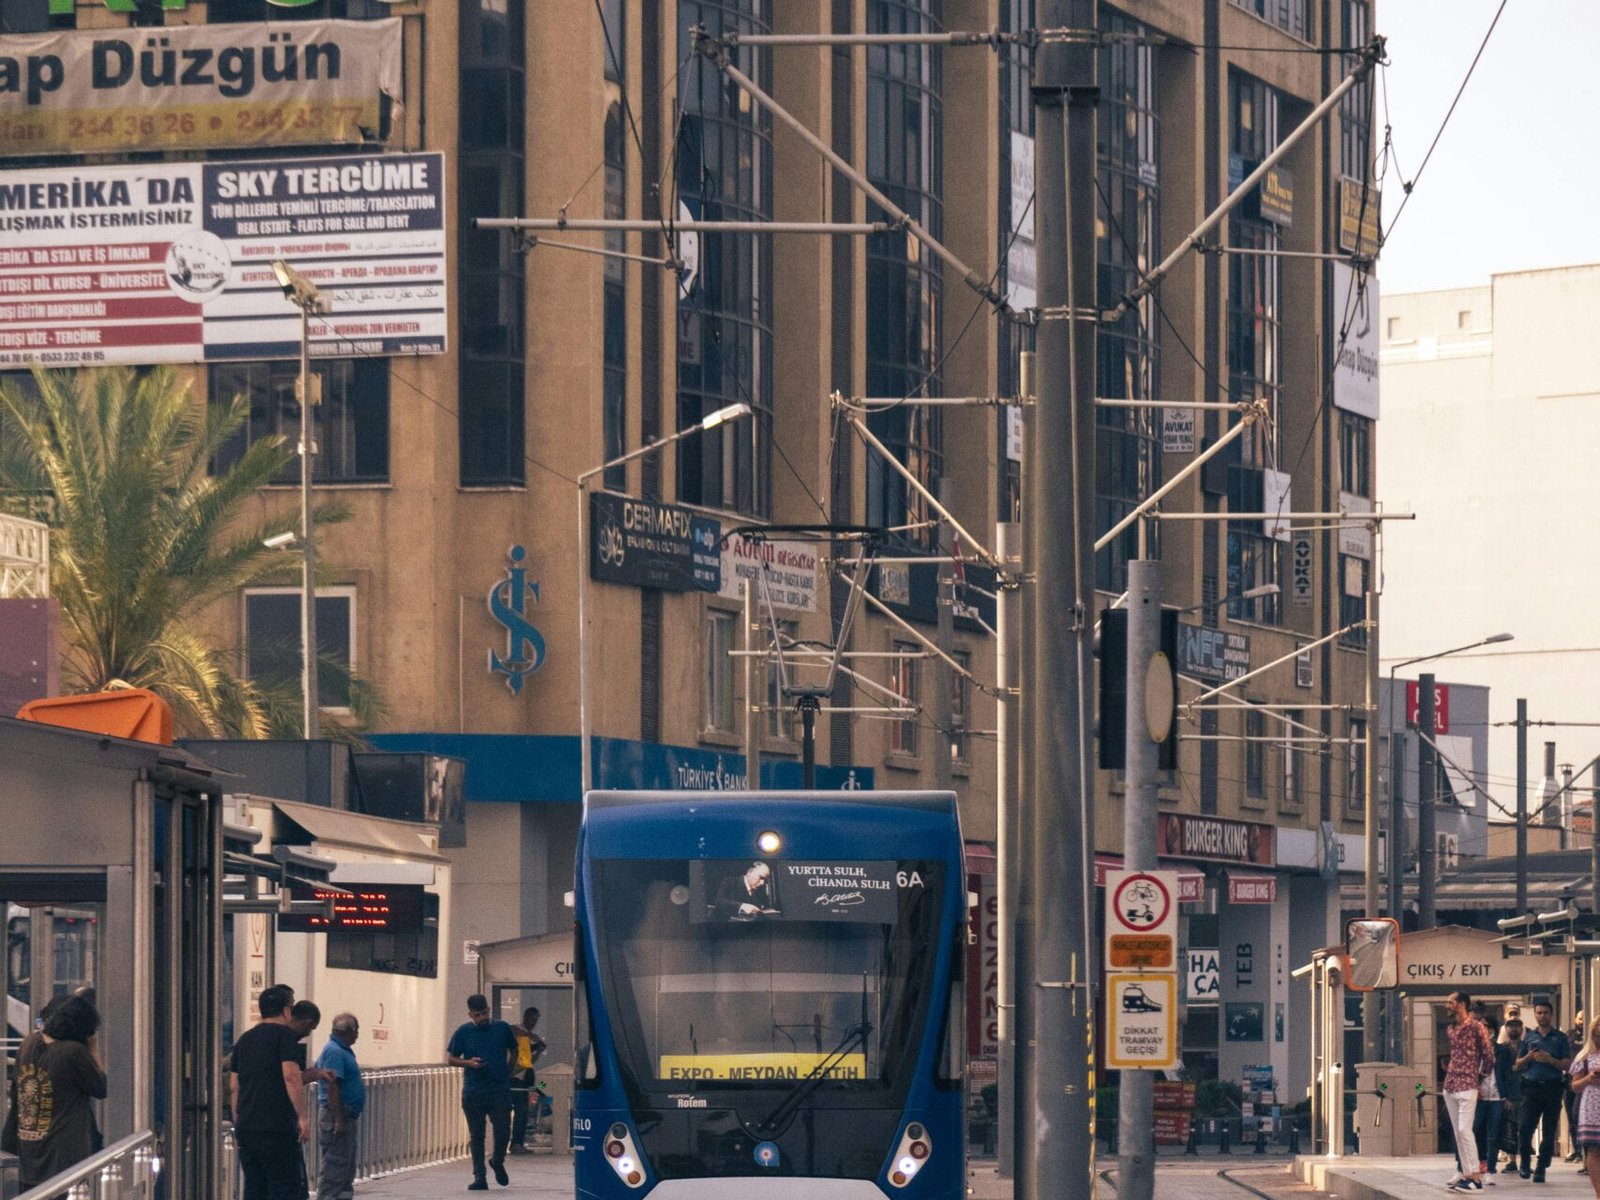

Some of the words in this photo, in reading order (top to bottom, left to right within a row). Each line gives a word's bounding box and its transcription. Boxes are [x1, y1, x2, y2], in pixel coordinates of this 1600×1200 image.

[91, 33, 341, 97] Düzgün
[164, 113, 196, 134] 26
[217, 169, 277, 198] SKY
[284, 161, 428, 195] TERCÜME
[0, 177, 131, 211] MERİKA
[70, 209, 193, 229] İSTERMİSİNİZ
[211, 203, 233, 218] TÜM
[237, 222, 259, 235] REAL
[261, 219, 291, 234] ESTATE
[298, 218, 323, 232] FLATS
[325, 218, 342, 231] FOR
[344, 216, 365, 230] SALE
[367, 216, 385, 229] AND
[387, 215, 409, 228] RENT
[79, 247, 93, 262] VE
[0, 278, 31, 294] TDIŞI
[54, 328, 102, 344] TERCÜME
[1165, 421, 1192, 432] AVUKAT
[624, 502, 692, 539] DERMAFIX
[1186, 629, 1224, 668] NFC
[678, 762, 715, 790] TÜRKİYE
[1185, 820, 1223, 853] BURGER
[1224, 826, 1247, 857] KING
[788, 866, 832, 876] YURTTA
[834, 867, 867, 877] SULH,
[896, 871, 924, 888] 6A
[808, 877, 858, 889] CİHANDA
[861, 880, 890, 890] SULH
[1236, 943, 1252, 989] TEB
[1407, 964, 1445, 979] ÇIKIŞ
[1461, 964, 1491, 976] EXIT
[1119, 1037, 1163, 1045] TRAMVAY
[1124, 1027, 1158, 1035] DİKKAT
[670, 1067, 714, 1079] EXPO
[729, 1066, 798, 1079] MEYDAN
[677, 1096, 707, 1108] Rotem
